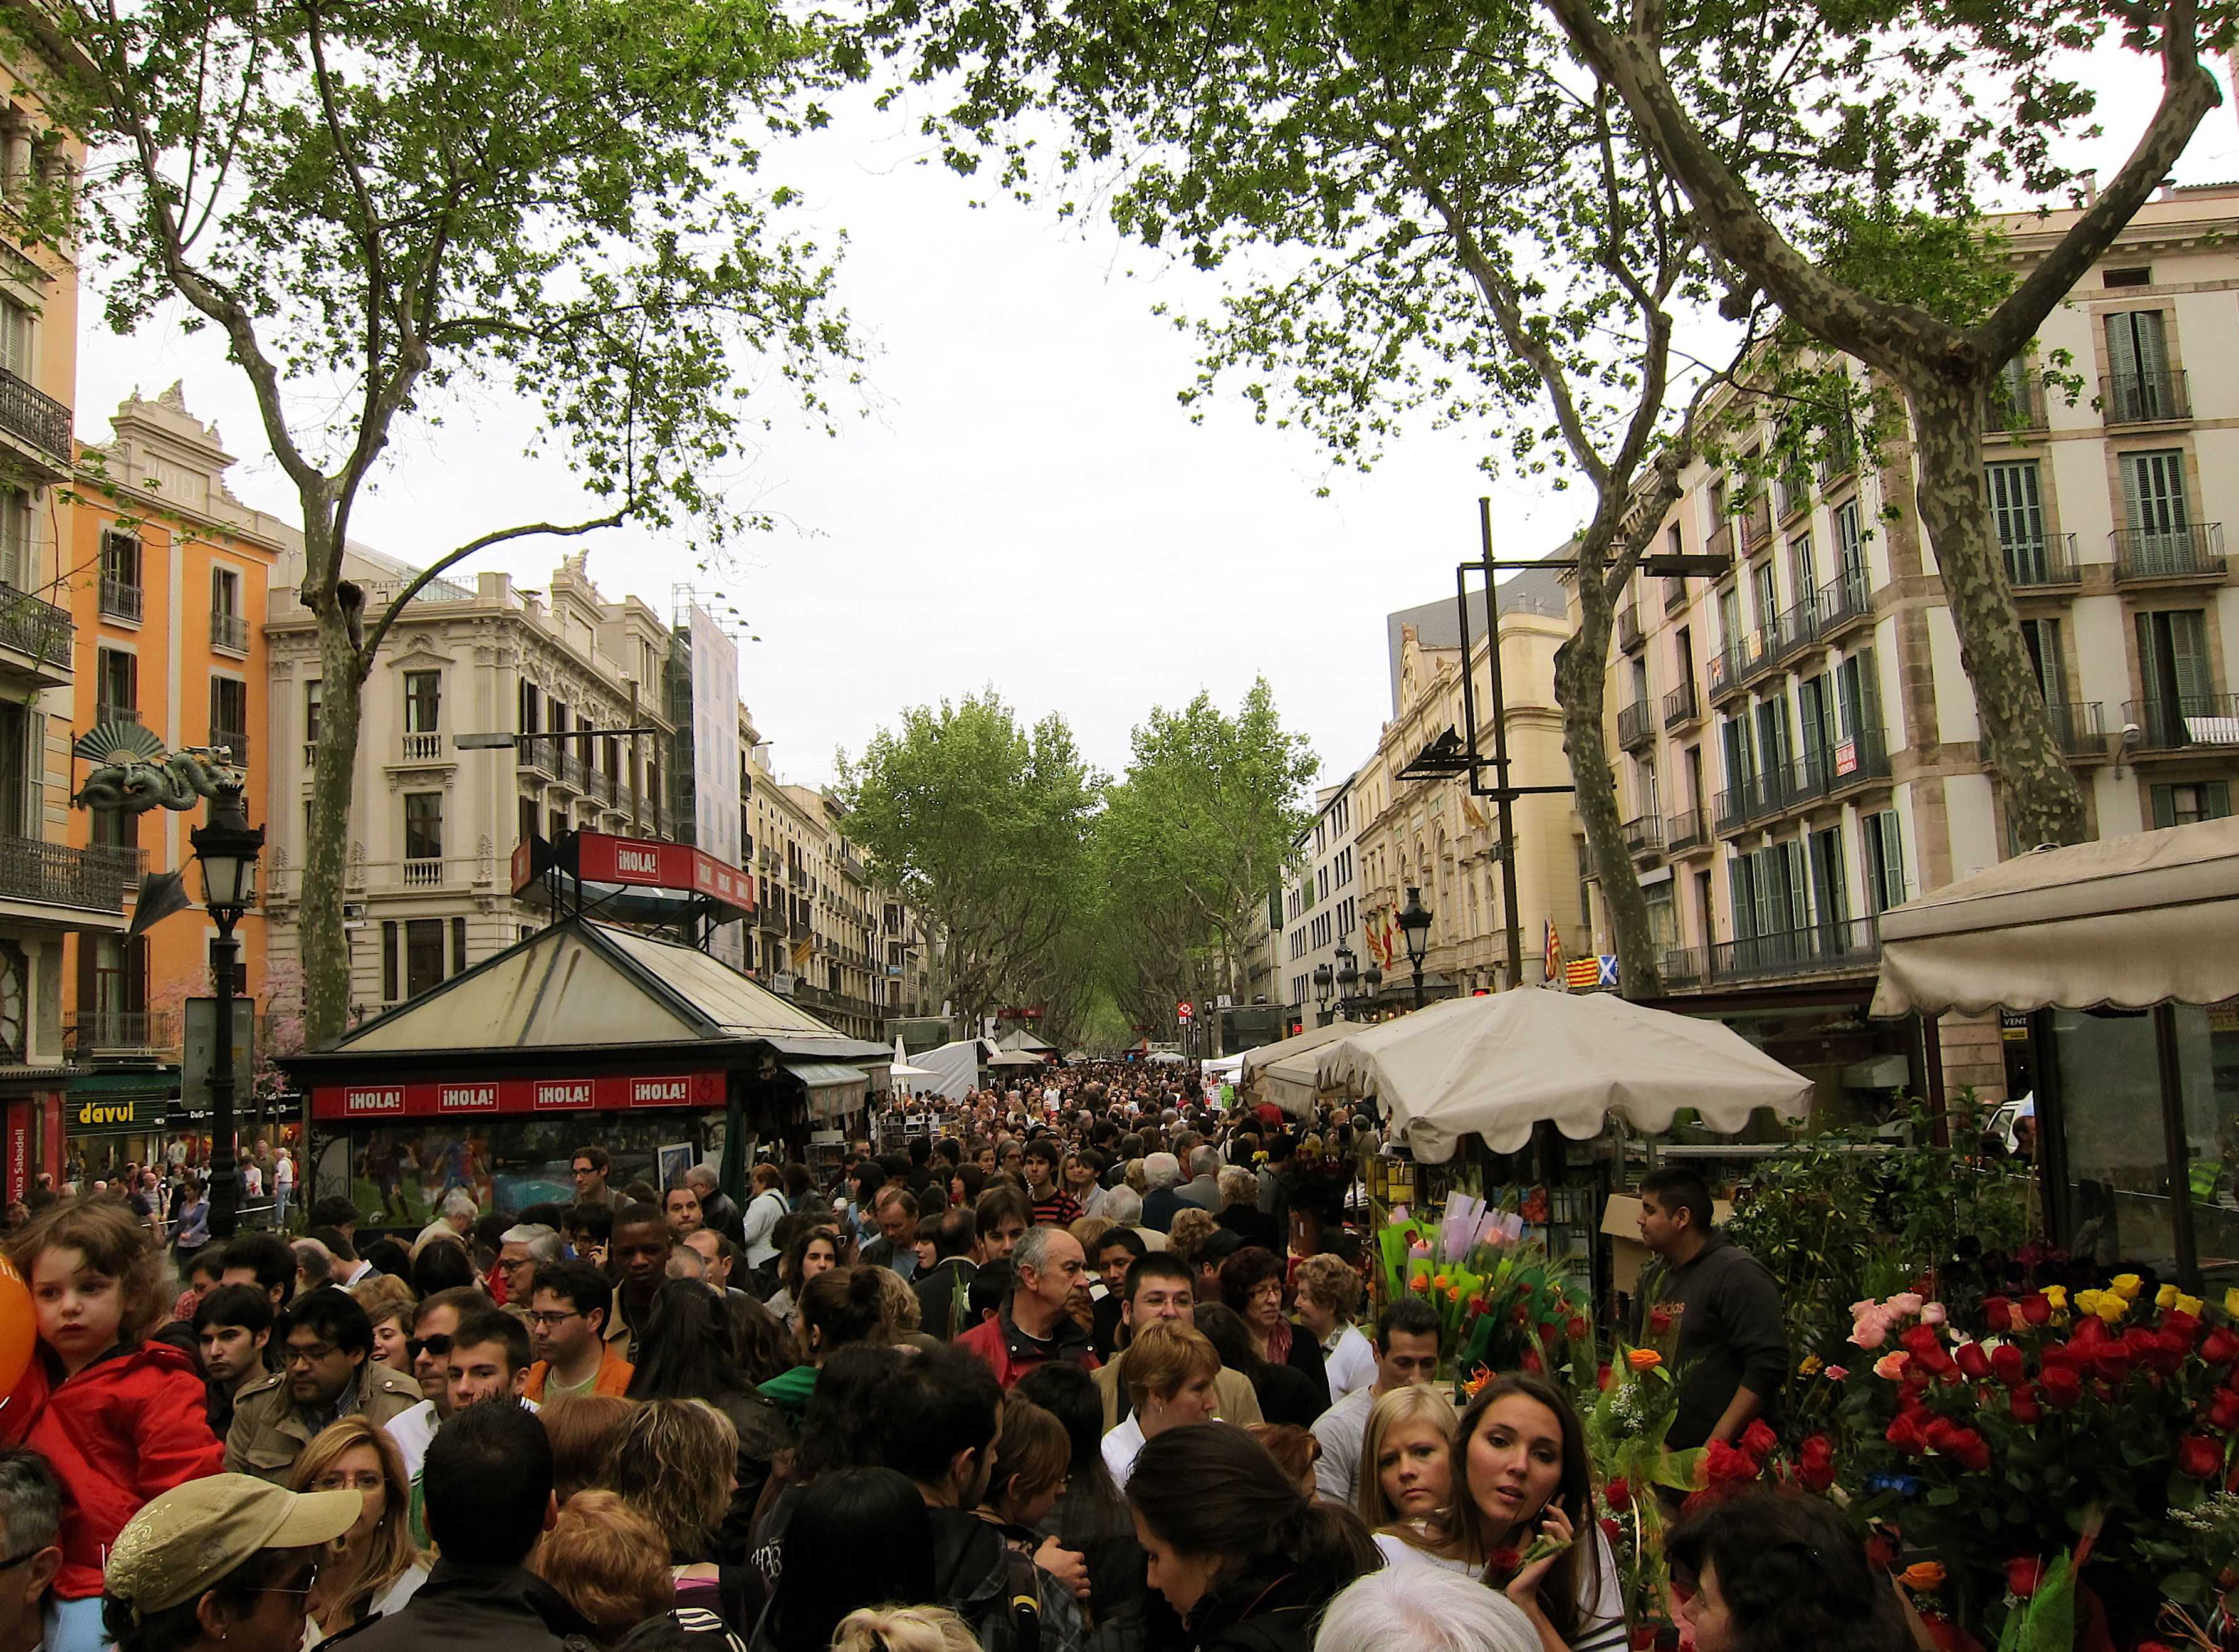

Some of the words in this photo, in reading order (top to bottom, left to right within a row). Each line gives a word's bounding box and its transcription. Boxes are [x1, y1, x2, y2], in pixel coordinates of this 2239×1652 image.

[146, 459, 201, 504] HOTEL
[619, 849, 656, 874] ¡HOLA!
[350, 1092, 400, 1109] ¡HOLA!
[443, 1089, 493, 1107] ¡HOLA!
[538, 1086, 590, 1104] ¡HOLA!
[635, 1083, 686, 1100] ¡HOLA!
[14, 1129, 24, 1174] Sabadell
[14, 1177, 23, 1201] aixa
